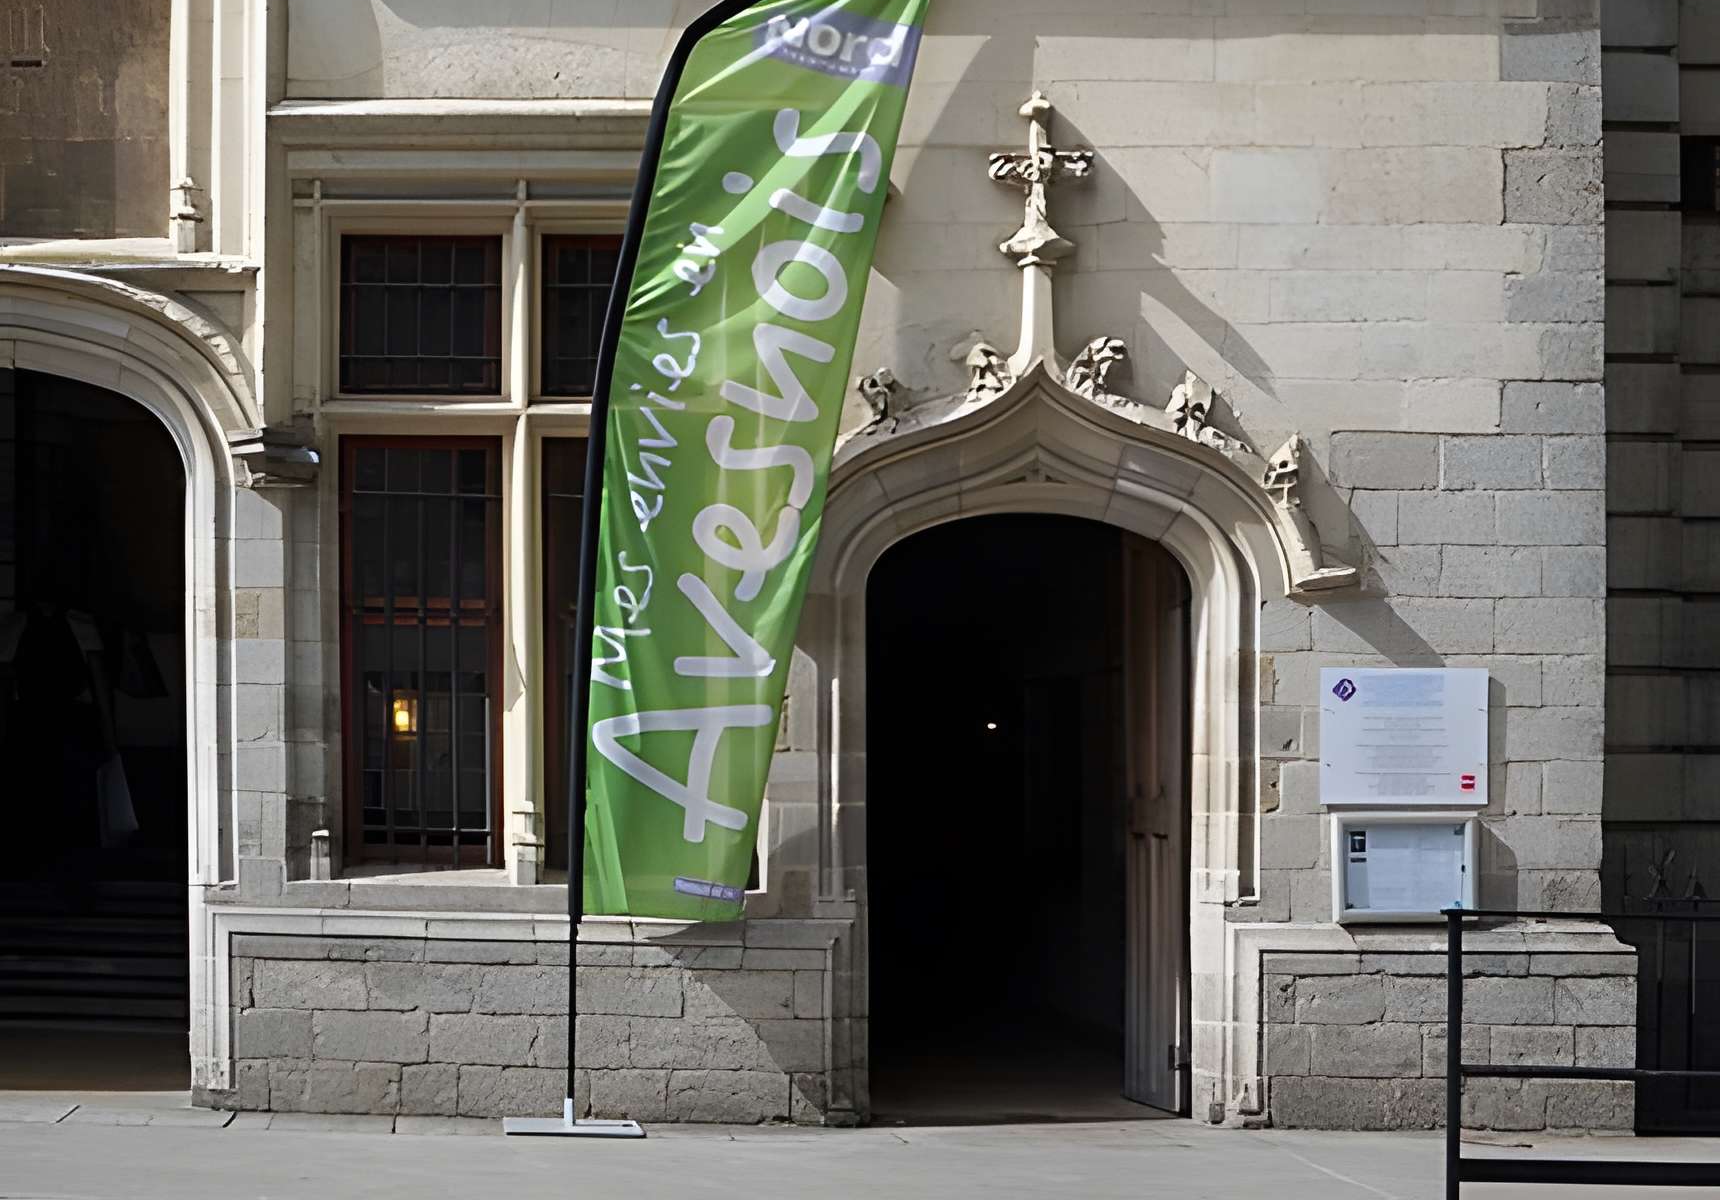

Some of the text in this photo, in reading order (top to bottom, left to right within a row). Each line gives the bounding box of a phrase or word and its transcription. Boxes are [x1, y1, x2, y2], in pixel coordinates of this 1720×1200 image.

[591, 222, 725, 691] Mes envies en
[591, 107, 882, 844] Avesnois
